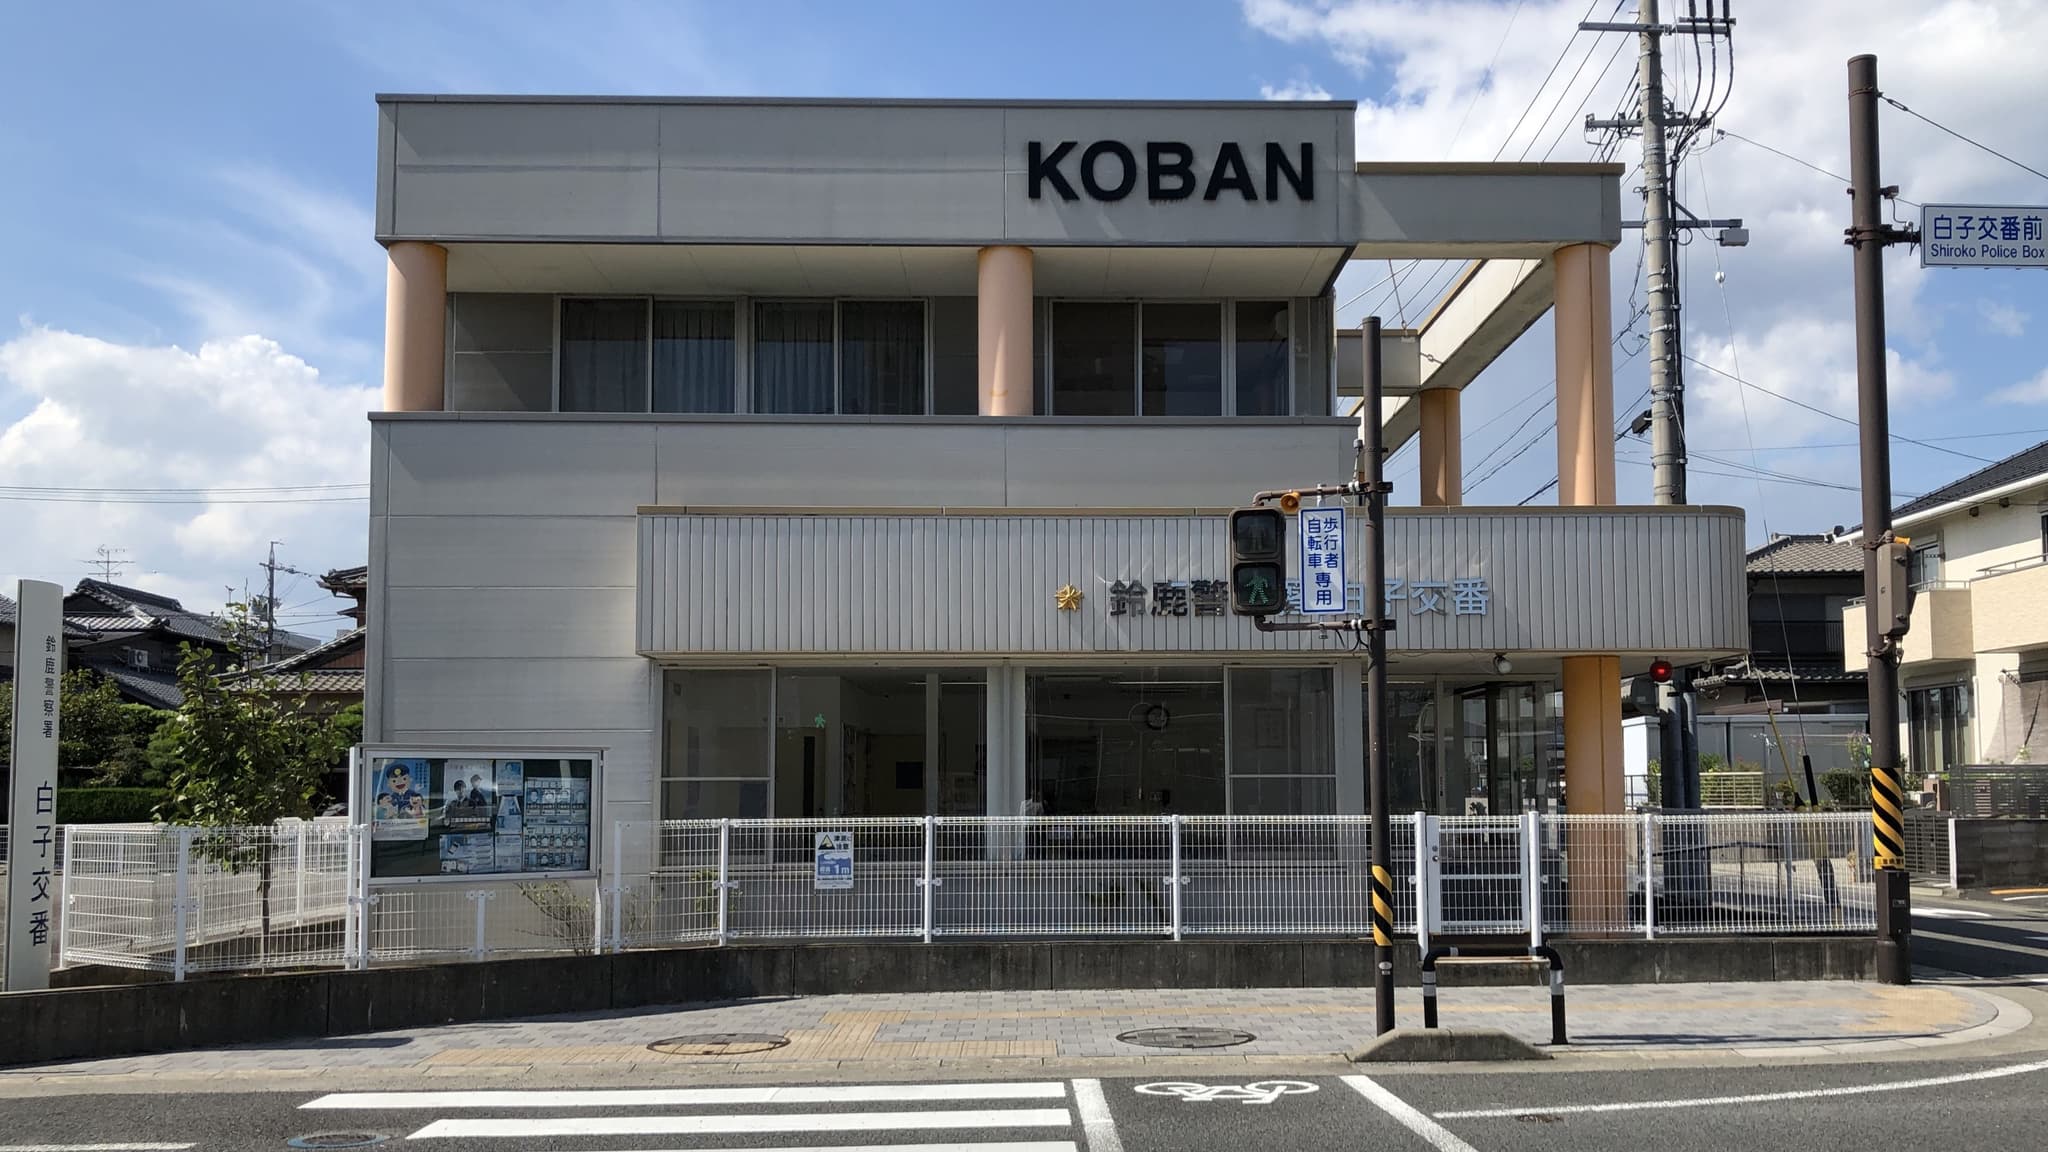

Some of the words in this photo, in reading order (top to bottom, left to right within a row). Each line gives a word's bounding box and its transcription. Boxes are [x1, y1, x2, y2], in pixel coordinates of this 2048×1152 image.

[1027, 139, 1314, 201] KOBAN
[1930, 243, 1977, 257] Shiroko
[1981, 244, 2017, 258] Police
[2022, 245, 2045, 258] Box
[1934, 214, 2043, 240] 白子交番前
[1308, 518, 1322, 568] 自転車
[1323, 517, 1339, 569] 歩行者
[1315, 572, 1332, 606] 専用
[42, 635, 56, 738] 鈴鹿警察署
[29, 780, 53, 946] 白子交番
